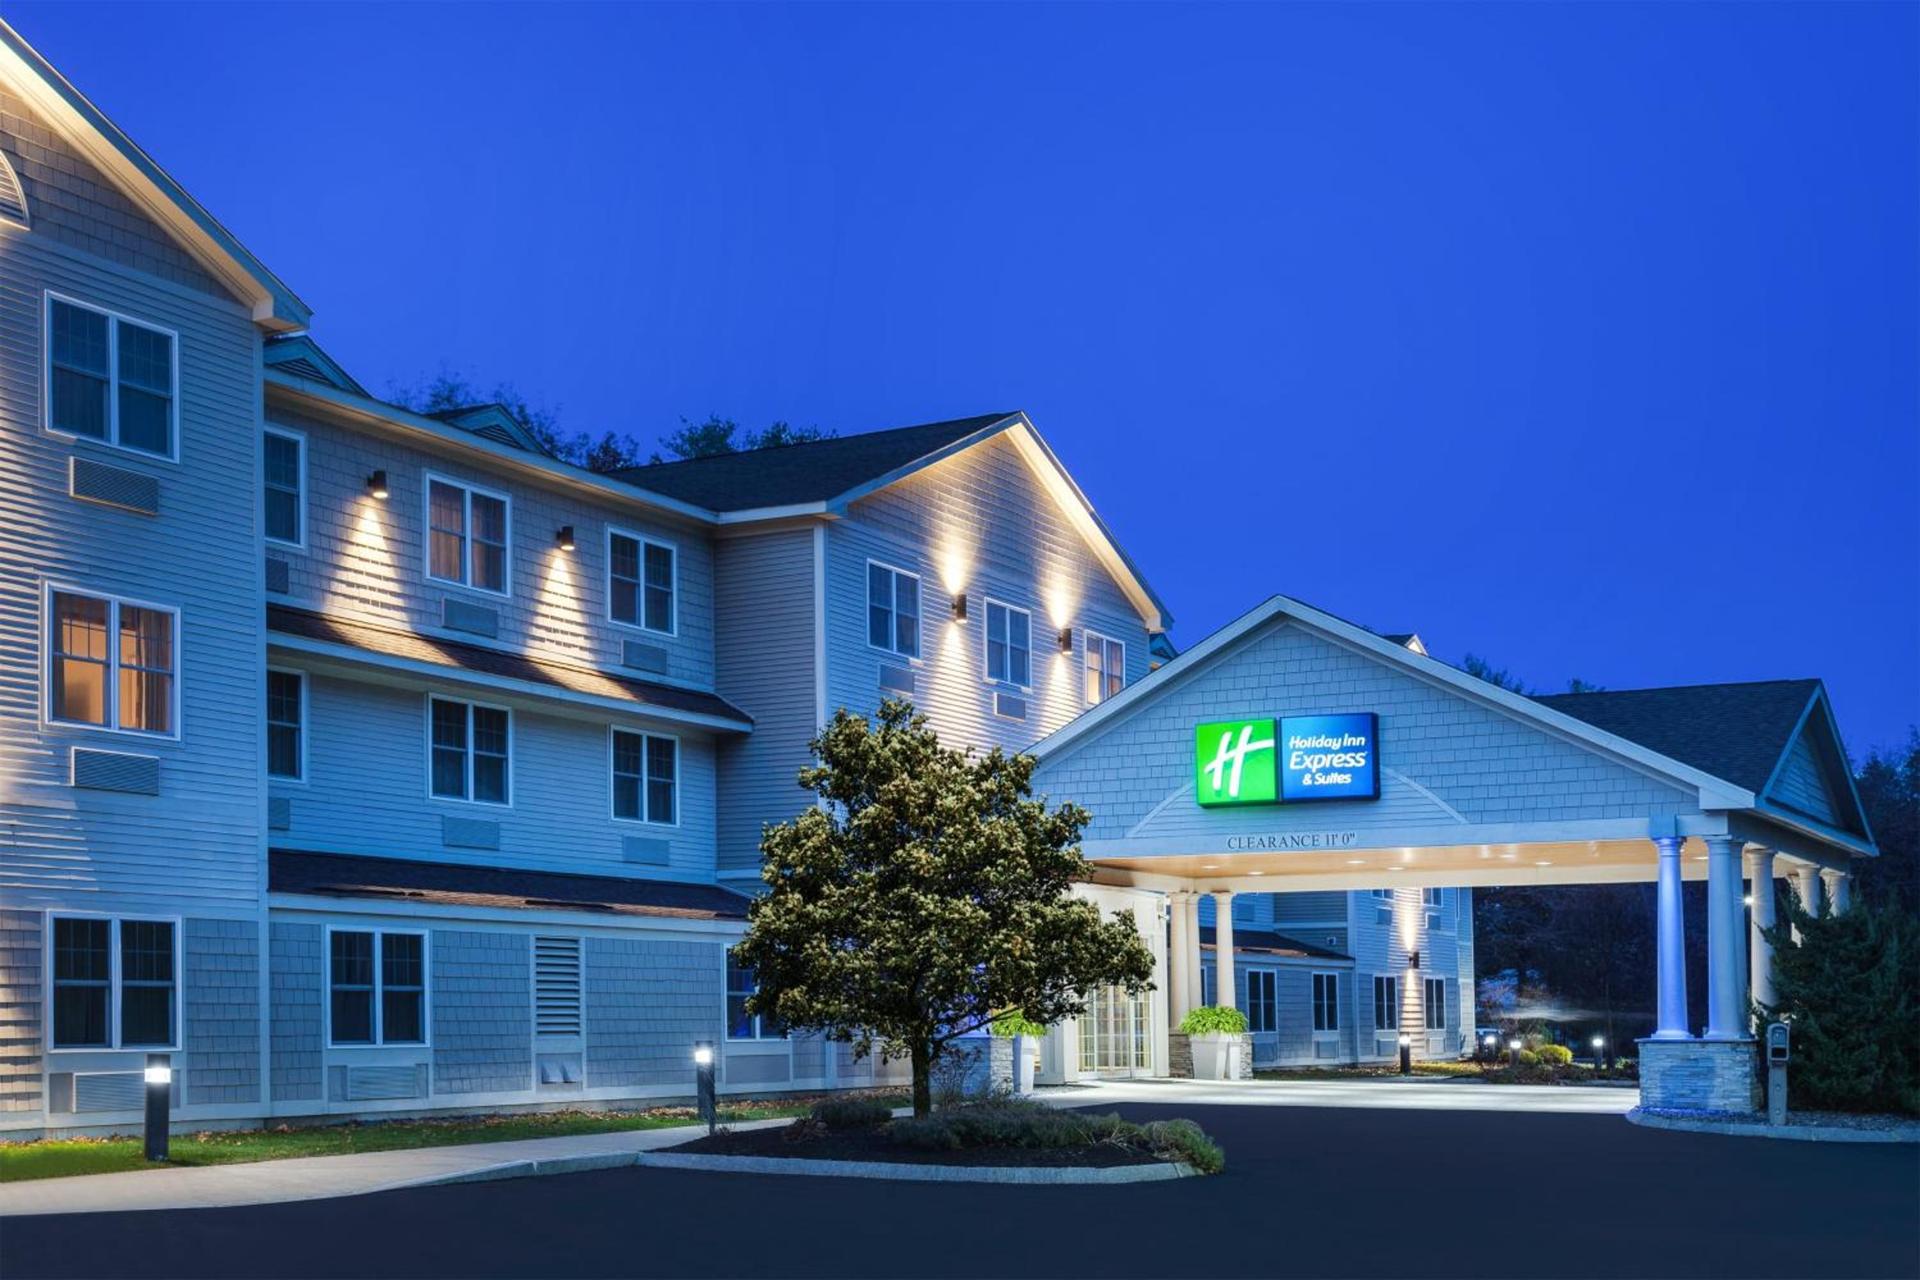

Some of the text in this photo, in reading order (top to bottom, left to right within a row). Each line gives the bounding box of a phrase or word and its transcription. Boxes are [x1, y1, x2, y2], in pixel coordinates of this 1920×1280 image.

[1289, 733, 1365, 750] Holiday Inn
[1204, 725, 1275, 797] H
[1289, 751, 1366, 773] Express
[1302, 773, 1352, 786] & Suites
[1227, 833, 1320, 850] CLEARANCE
